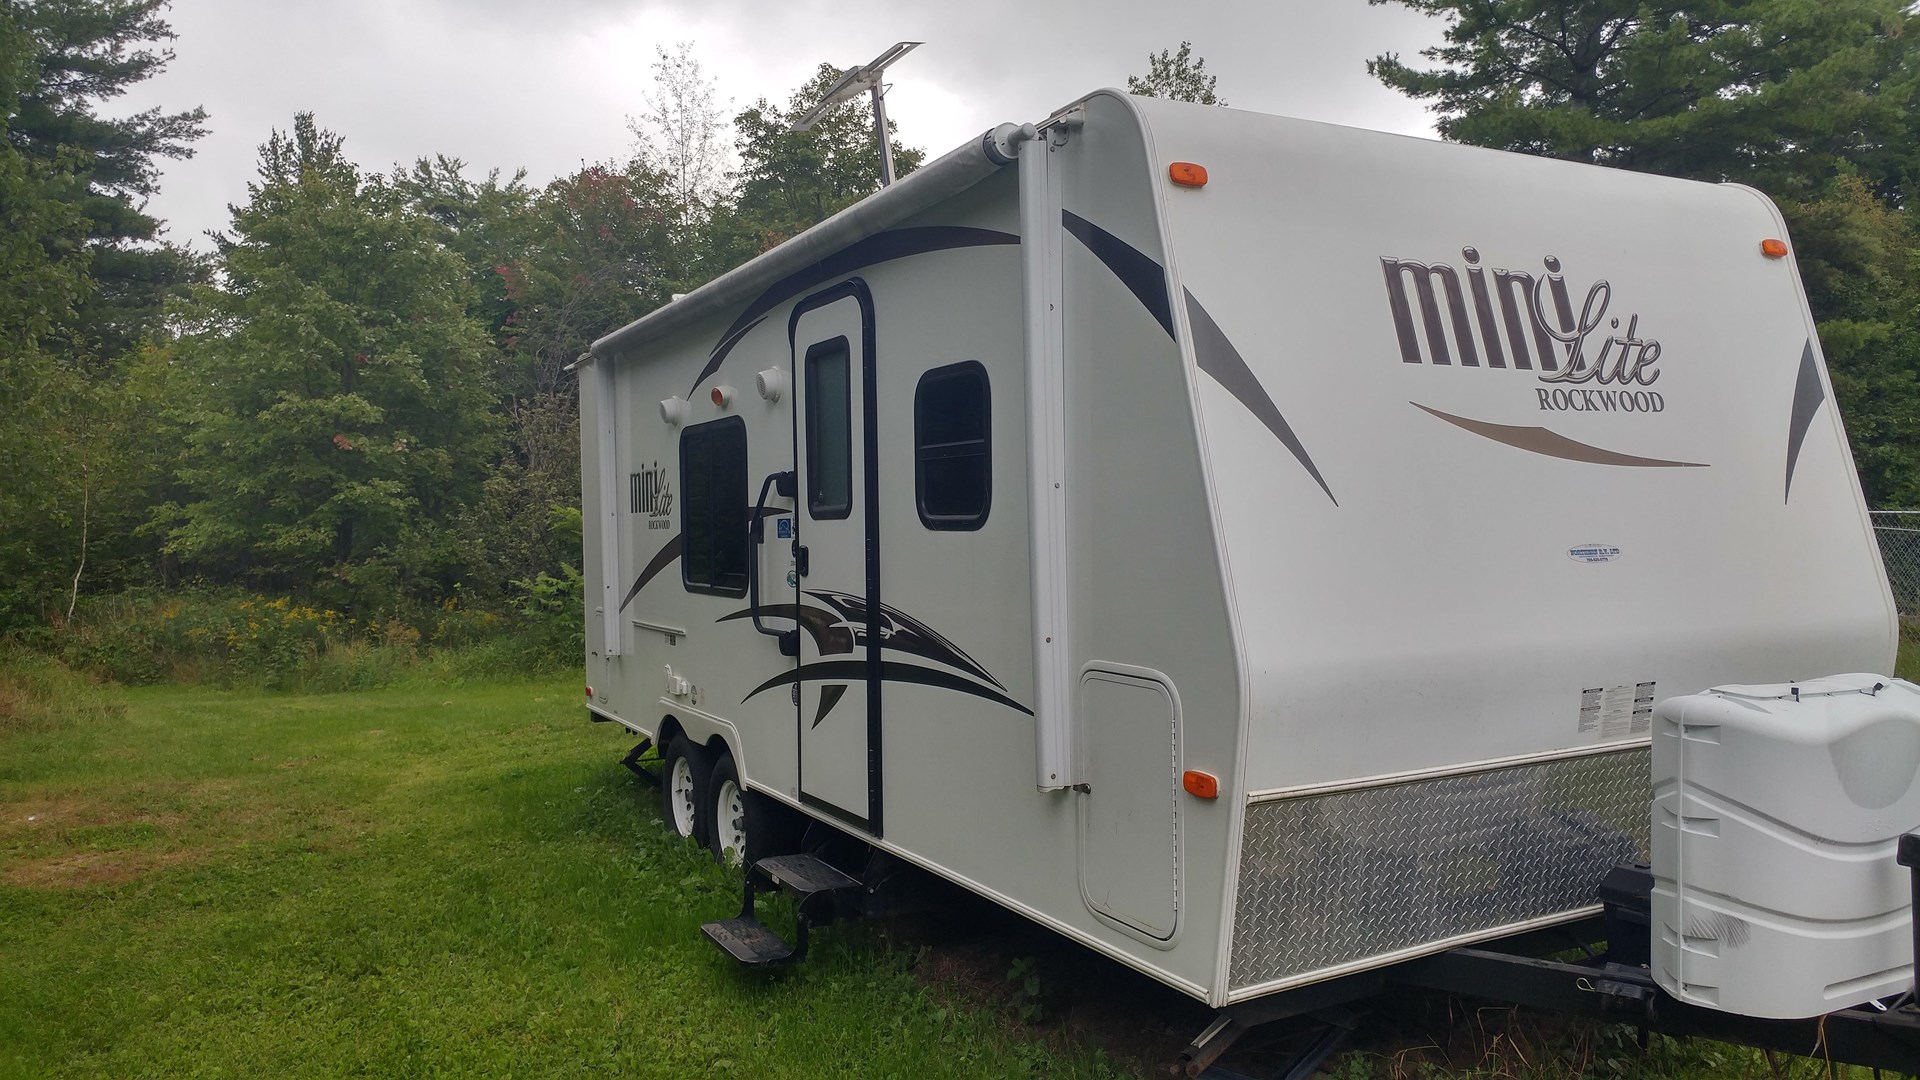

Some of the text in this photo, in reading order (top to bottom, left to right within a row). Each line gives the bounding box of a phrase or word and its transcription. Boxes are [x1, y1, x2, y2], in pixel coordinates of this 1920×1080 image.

[1379, 246, 1661, 385] mini Lite
[1535, 387, 1665, 413] ROCKWOOD
[630, 460, 673, 517] mini Lite
[648, 519, 671, 530] ROCKWOOD
